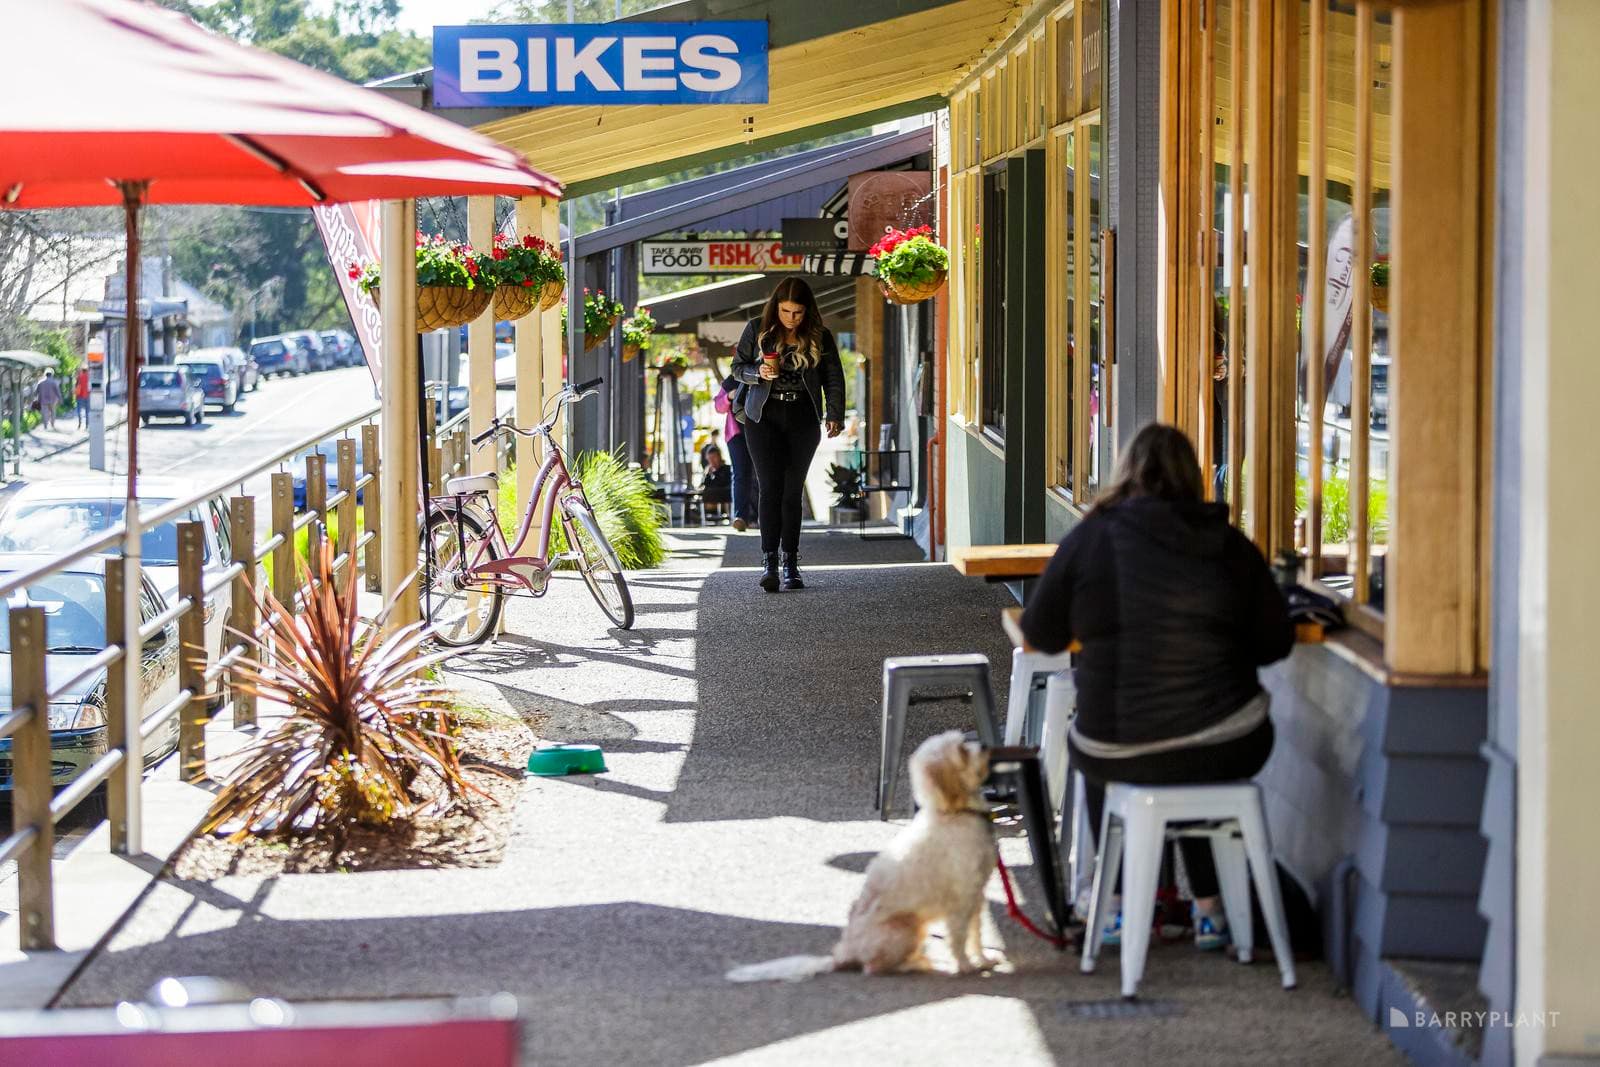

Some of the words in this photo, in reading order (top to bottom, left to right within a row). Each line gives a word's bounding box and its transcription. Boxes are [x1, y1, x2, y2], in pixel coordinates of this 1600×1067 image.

[459, 35, 742, 92] BIKES
[650, 247, 674, 255] TAKE
[709, 243, 751, 265] FISH
[652, 254, 703, 267] FOOD
